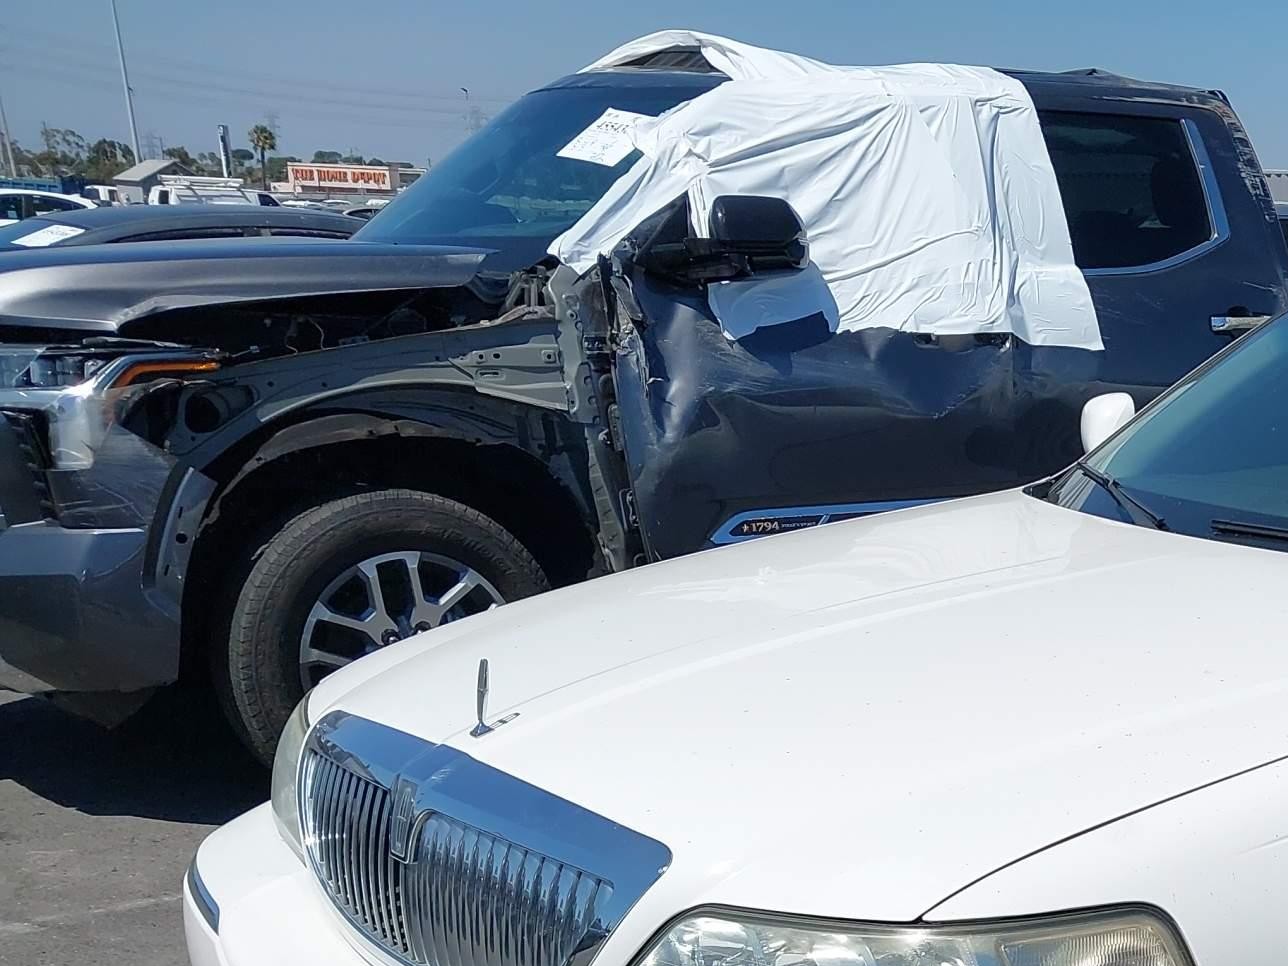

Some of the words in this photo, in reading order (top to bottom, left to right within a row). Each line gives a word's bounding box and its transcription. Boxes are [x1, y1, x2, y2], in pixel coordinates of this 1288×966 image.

[292, 168, 315, 181] THE
[317, 169, 348, 182] HOME
[351, 171, 386, 185] DEPOT
[749, 521, 780, 533] 1794
